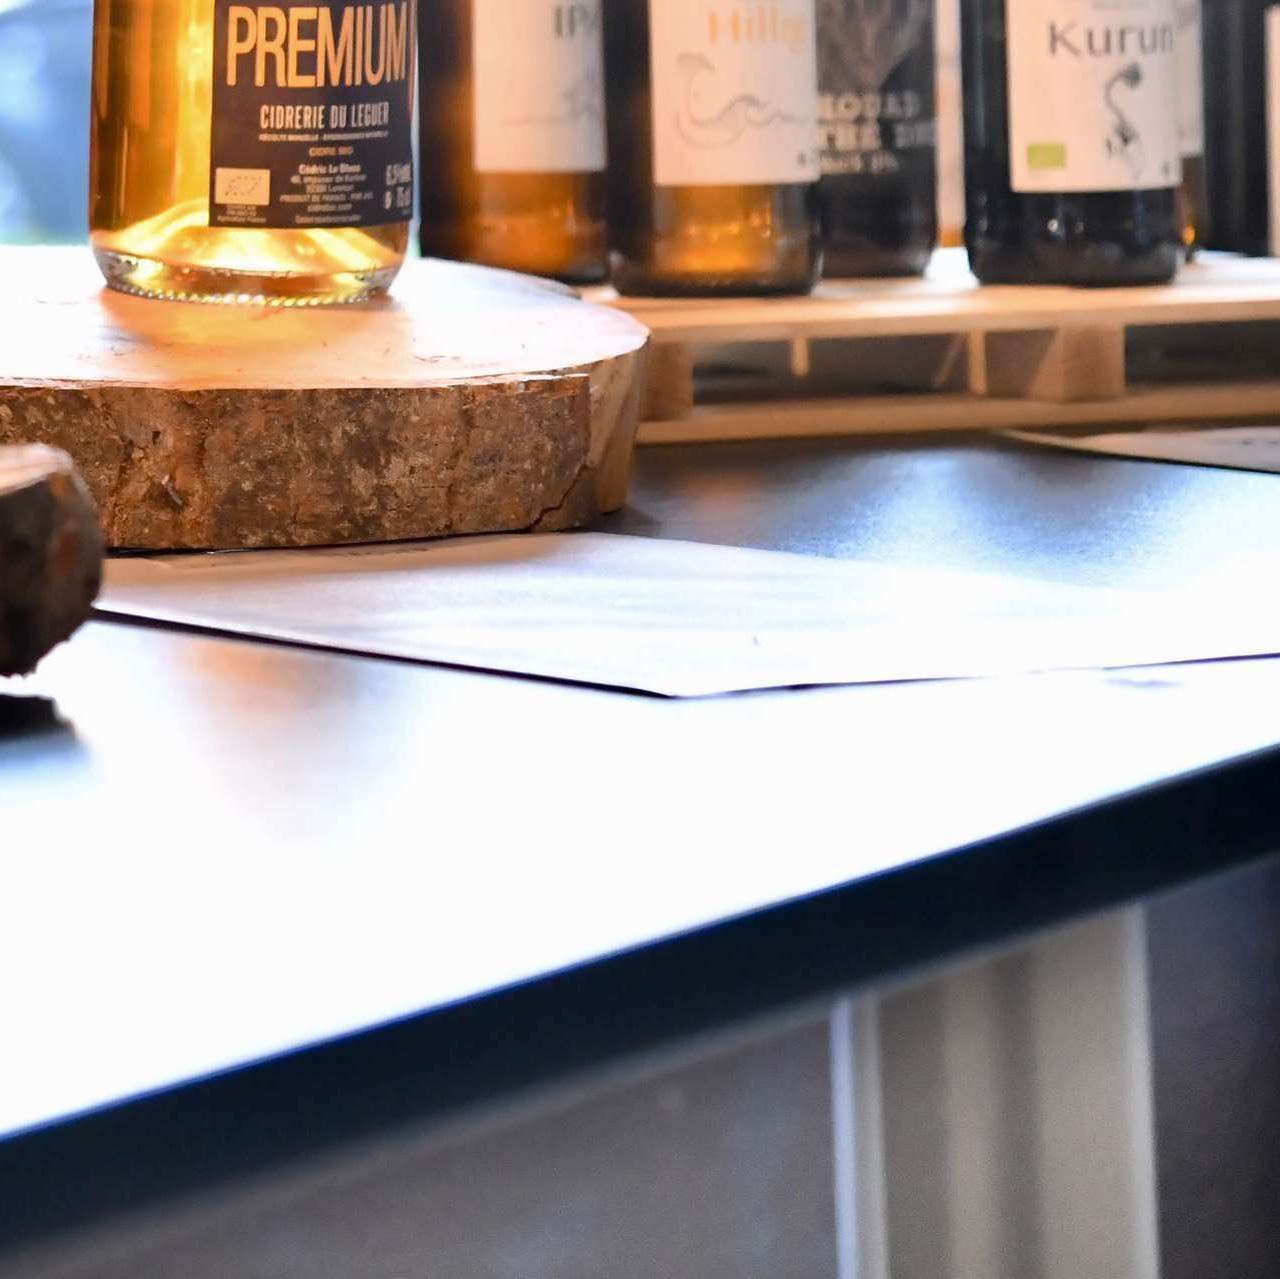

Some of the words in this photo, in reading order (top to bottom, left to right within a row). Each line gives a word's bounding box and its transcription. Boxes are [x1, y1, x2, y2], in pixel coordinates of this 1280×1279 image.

[226, 1, 408, 89] PREMIUM
[260, 104, 325, 130] CIDRERIE
[330, 103, 348, 128] DU
[351, 101, 390, 127] LEGUER
